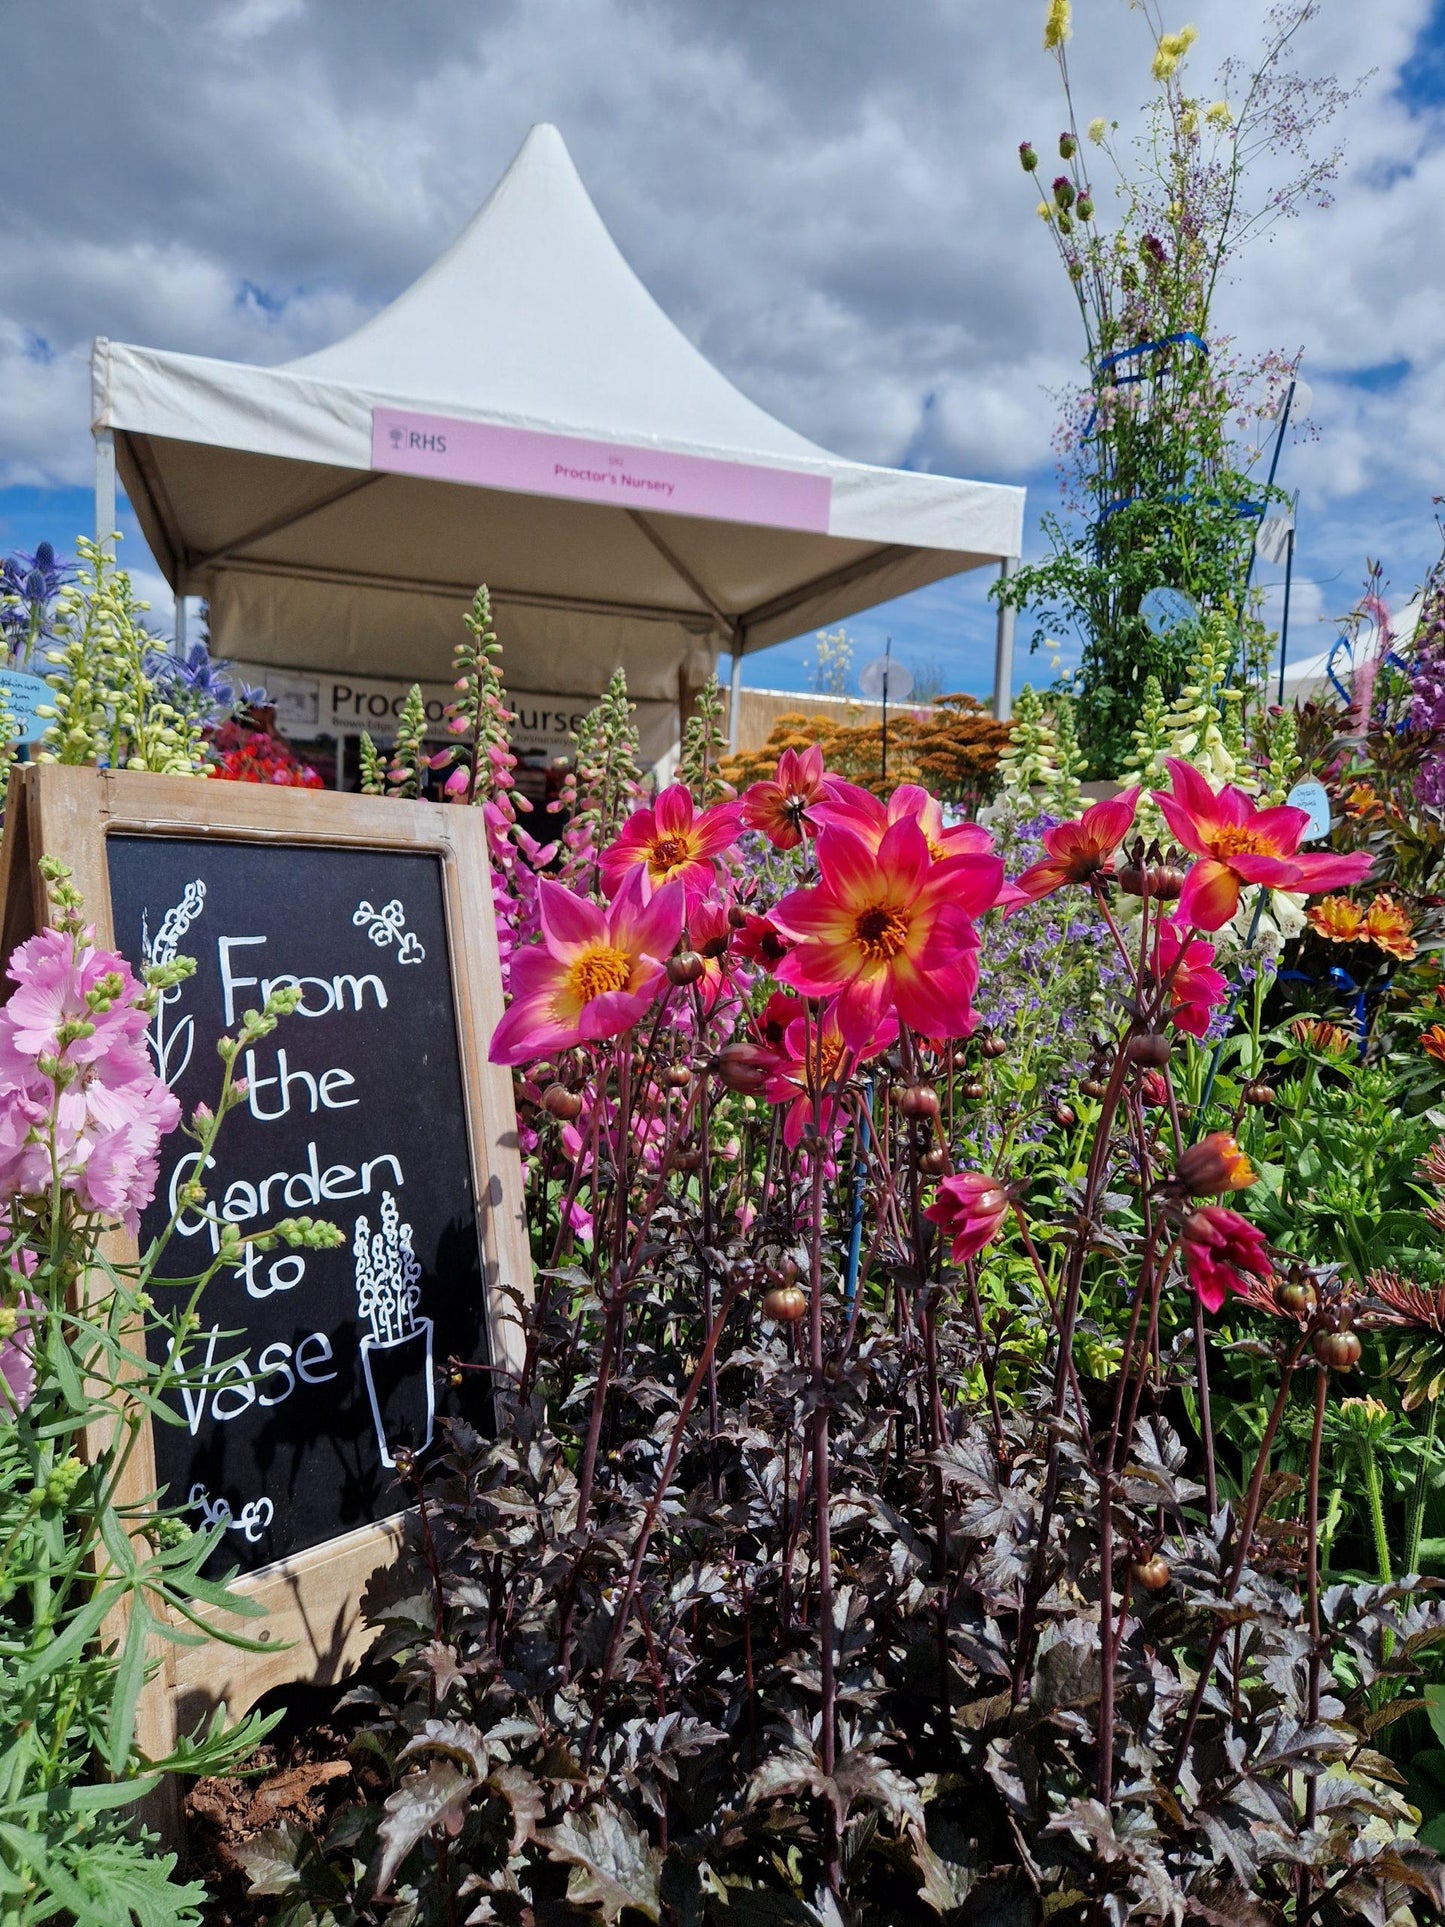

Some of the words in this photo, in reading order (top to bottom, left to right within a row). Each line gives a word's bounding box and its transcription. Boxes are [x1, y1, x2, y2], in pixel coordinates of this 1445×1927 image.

[410, 432, 447, 453] RHS
[554, 464, 617, 485] Proctor's
[622, 474, 674, 496] Nursery
[218, 936, 388, 1027] From
[245, 1049, 360, 1120] the
[168, 1142, 404, 1254] Garden
[234, 1241, 305, 1298] to
[167, 1323, 338, 1436] Vase
